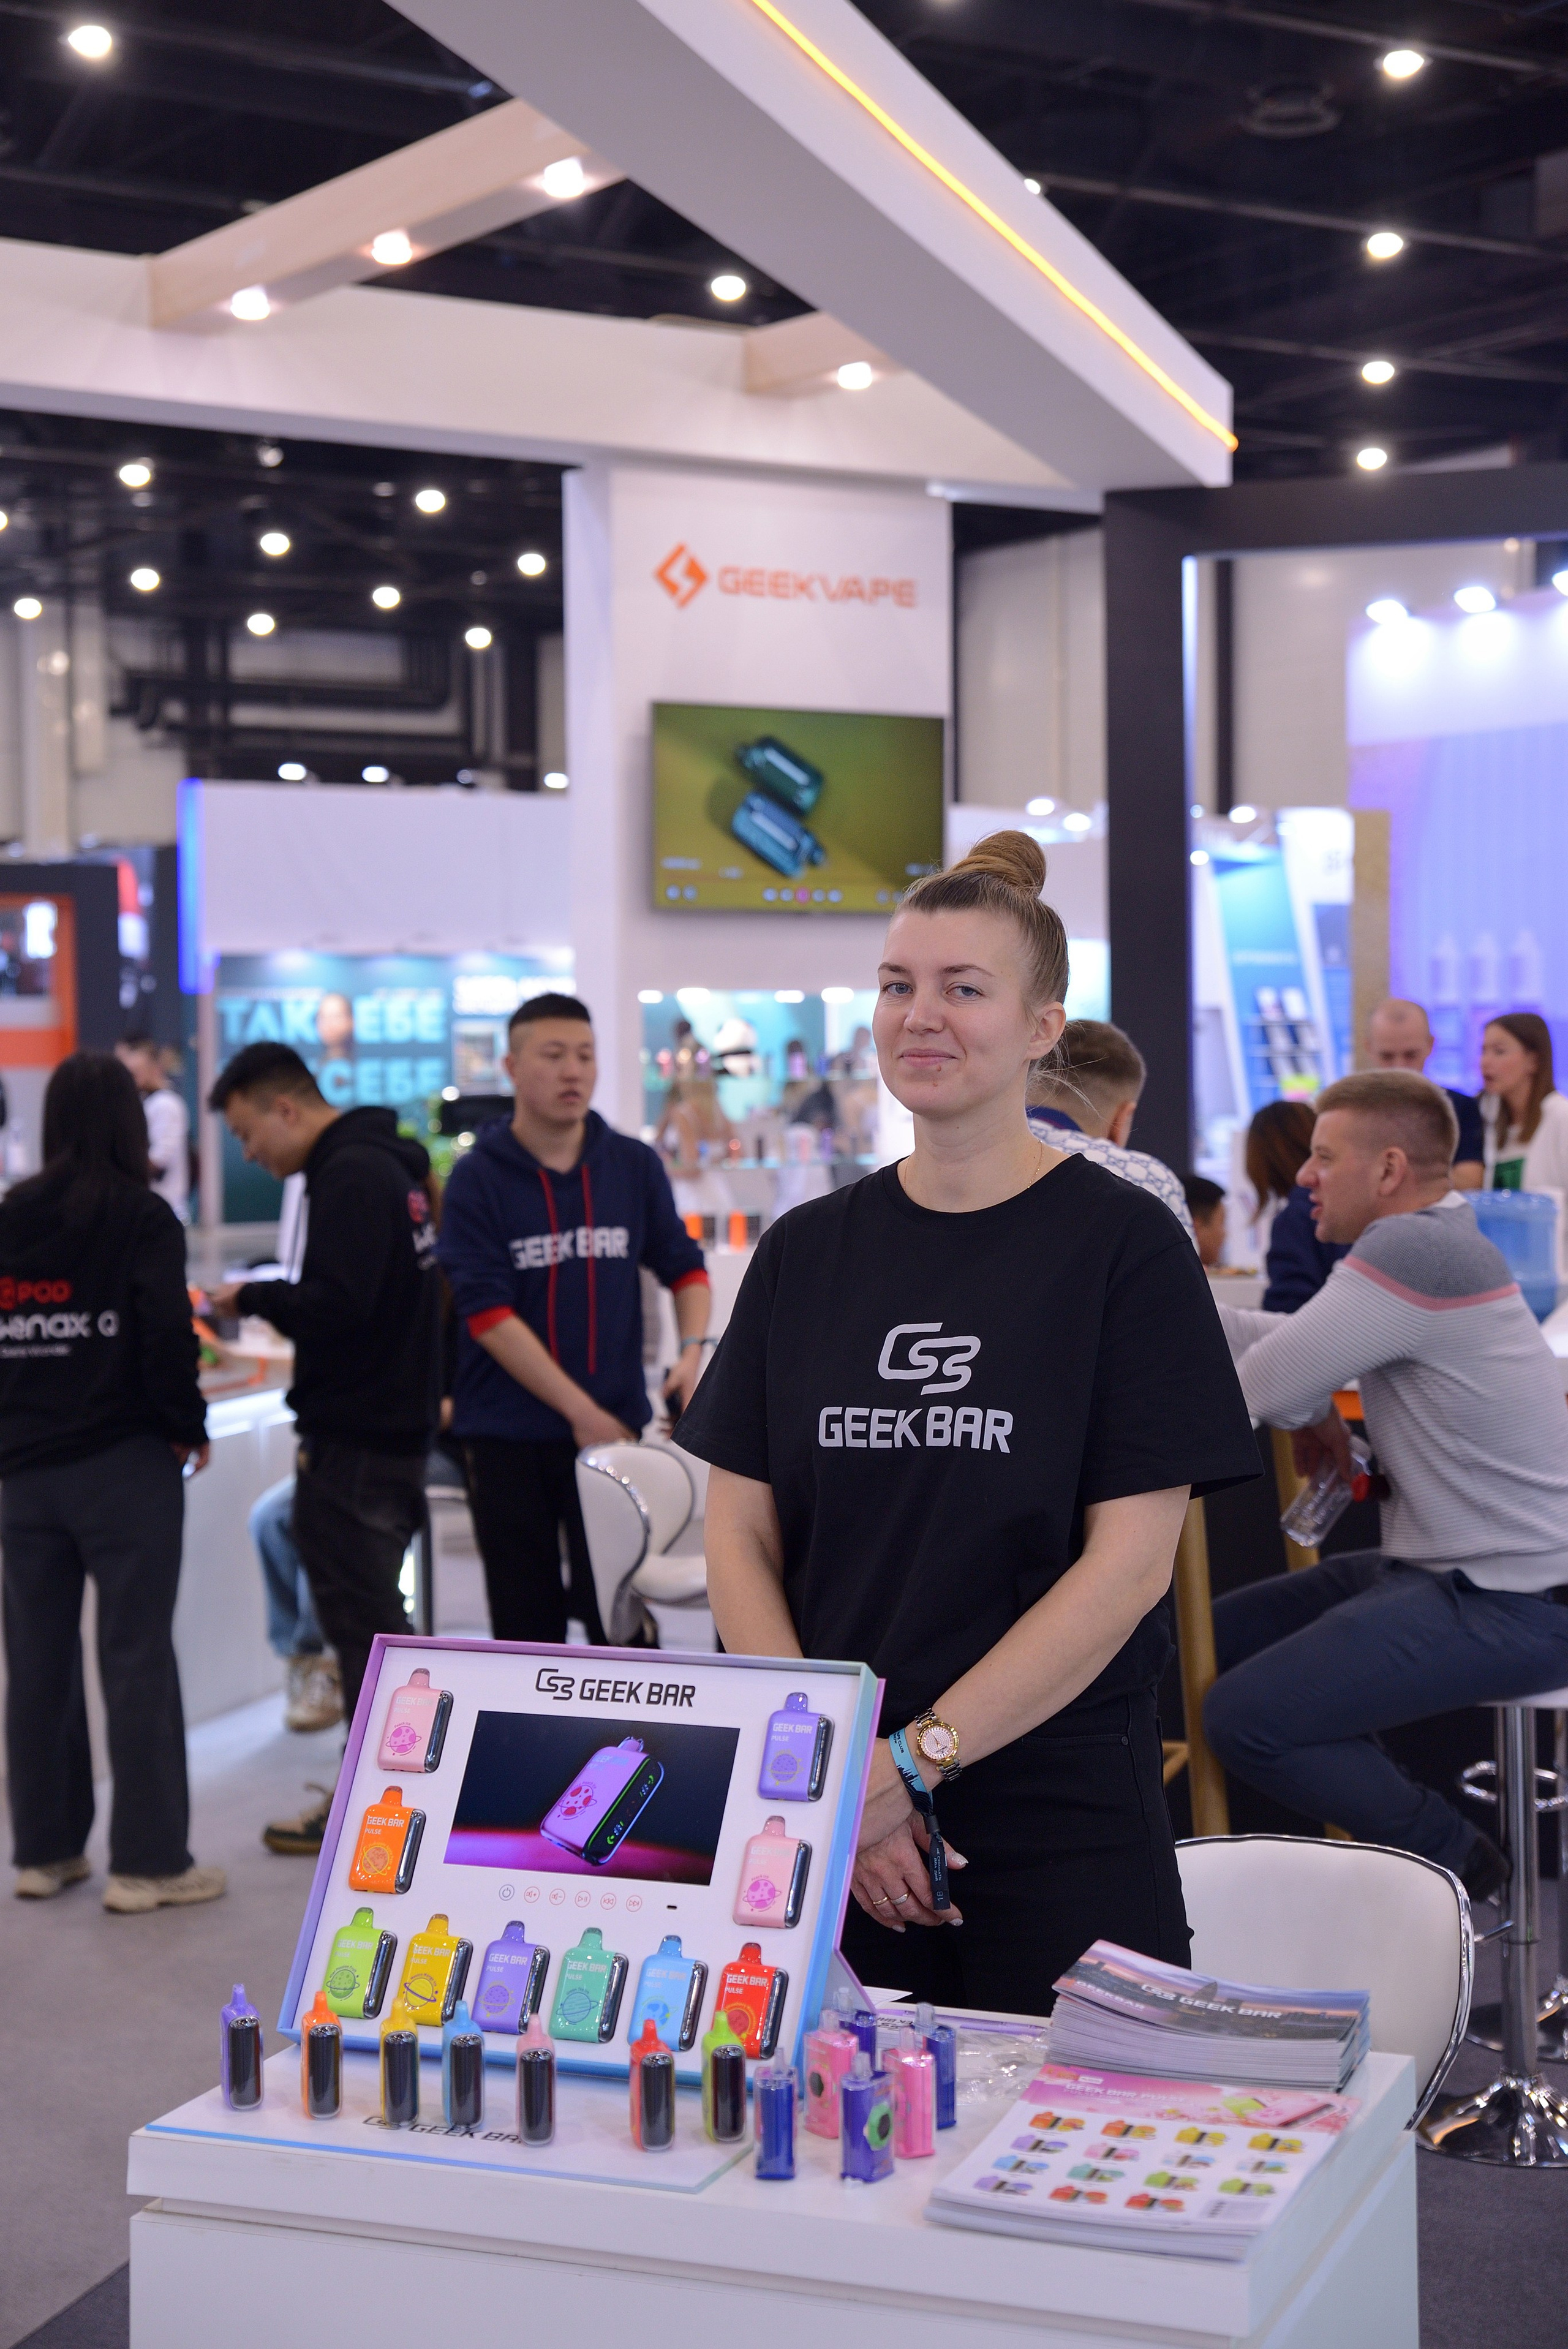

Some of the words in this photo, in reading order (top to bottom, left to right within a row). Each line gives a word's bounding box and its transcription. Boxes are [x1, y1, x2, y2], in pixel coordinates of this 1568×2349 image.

[718, 565, 916, 608] GEEKVAPE
[818, 1406, 922, 1448] GEEK
[925, 1406, 1014, 1454] BAR
[579, 1678, 644, 1704] GEEK
[646, 1683, 696, 1708] BAR
[772, 1722, 794, 1733] GEEK
[794, 1724, 813, 1734] BAR
[368, 1816, 388, 1826] GEEK
[387, 1818, 404, 1827] BAR
[337, 1939, 356, 1948] GEEK
[356, 1940, 373, 1950] BAR
[413, 1945, 434, 1955] GEEK
[434, 1947, 451, 1957] BAR
[489, 1953, 510, 1964] GEEK
[510, 1955, 528, 1966] BAR
[568, 1961, 588, 1971] GEEK
[588, 1963, 607, 1973] BAR
[727, 1974, 750, 1985] GEEK
[749, 1976, 767, 1986] BAR
[1178, 1997, 1236, 2015] GEEK
[1237, 2008, 1283, 2020] BAR
[1065, 2083, 1106, 2094] GEEK
[1106, 2089, 1137, 2099] BAR
[481, 2131, 522, 2144] BA
